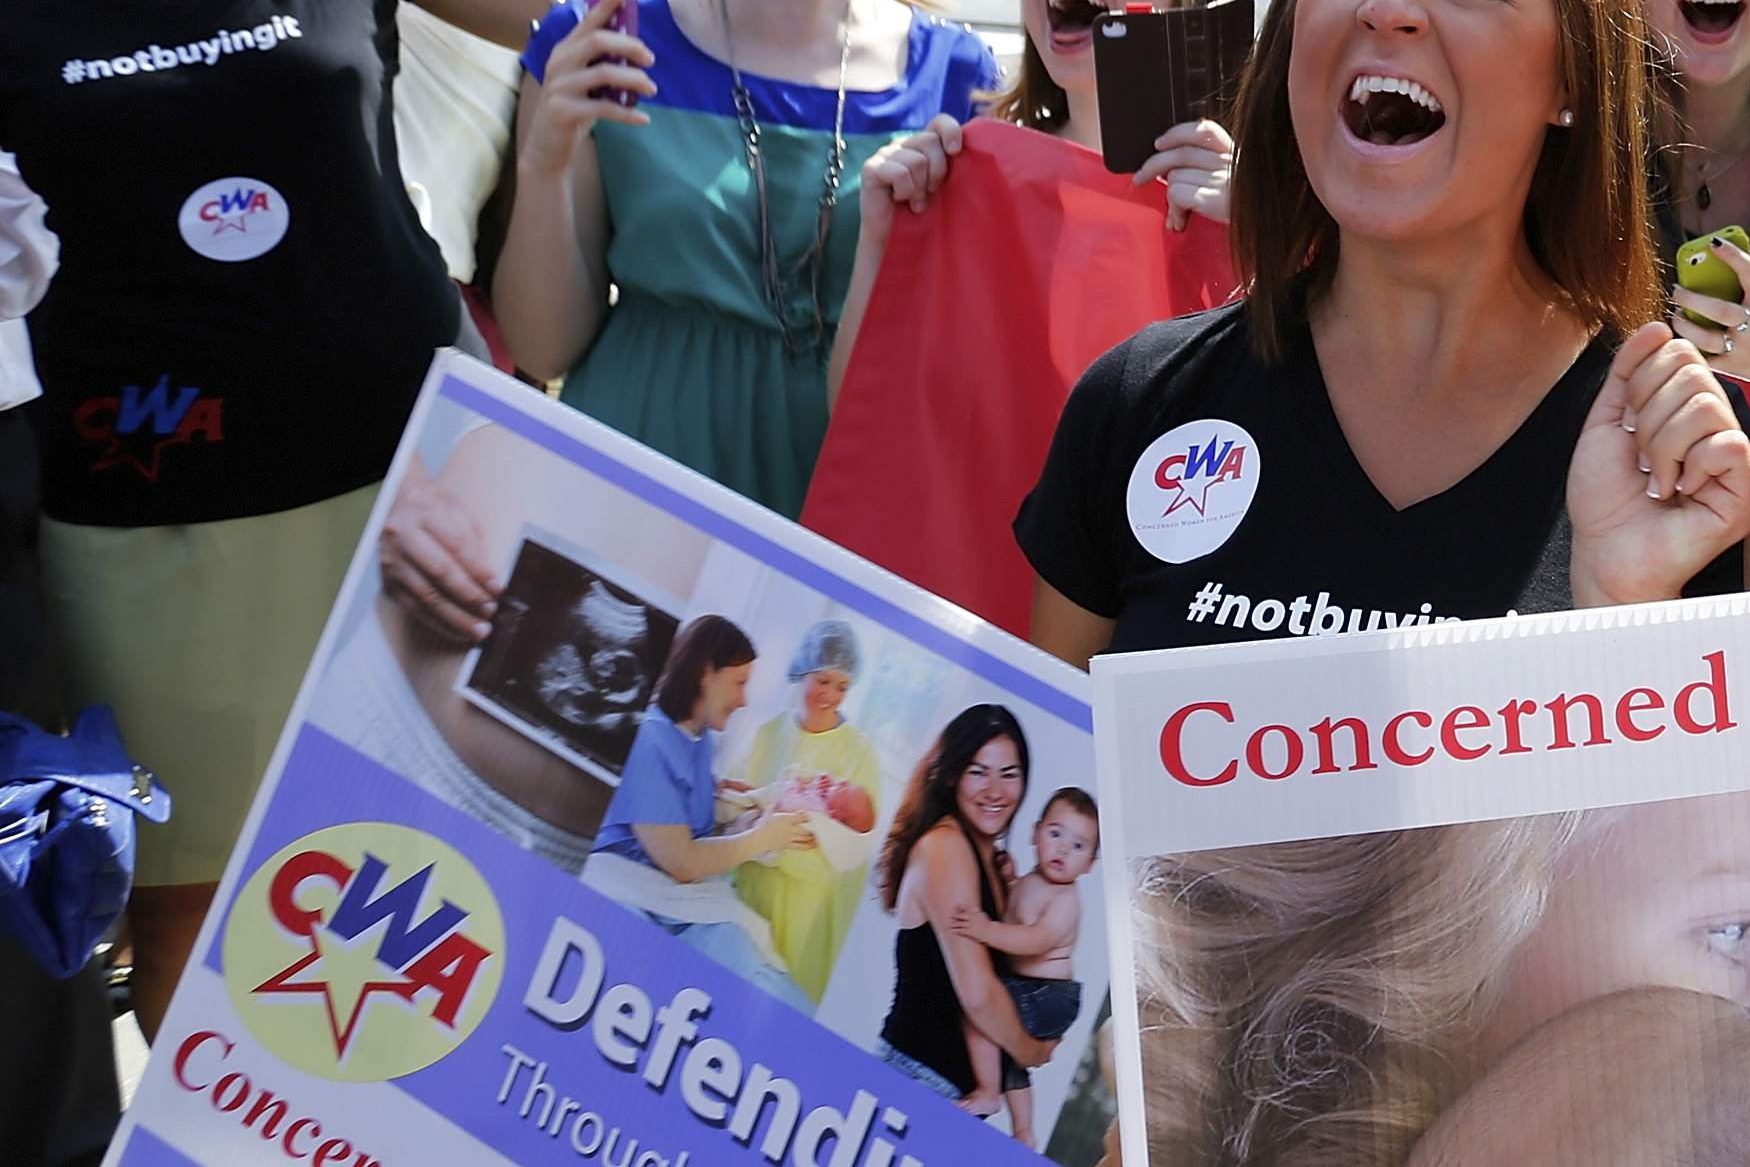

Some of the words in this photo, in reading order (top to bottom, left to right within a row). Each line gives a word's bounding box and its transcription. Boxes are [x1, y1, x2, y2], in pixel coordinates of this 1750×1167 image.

[62, 15, 303, 84] #notbuyingit
[199, 186, 269, 222] CWA
[73, 372, 224, 442] CWA
[1154, 433, 1248, 491] CWA
[1158, 650, 1738, 788] Concerned
[268, 850, 494, 1031] CWA
[522, 915, 924, 1167] Defendi
